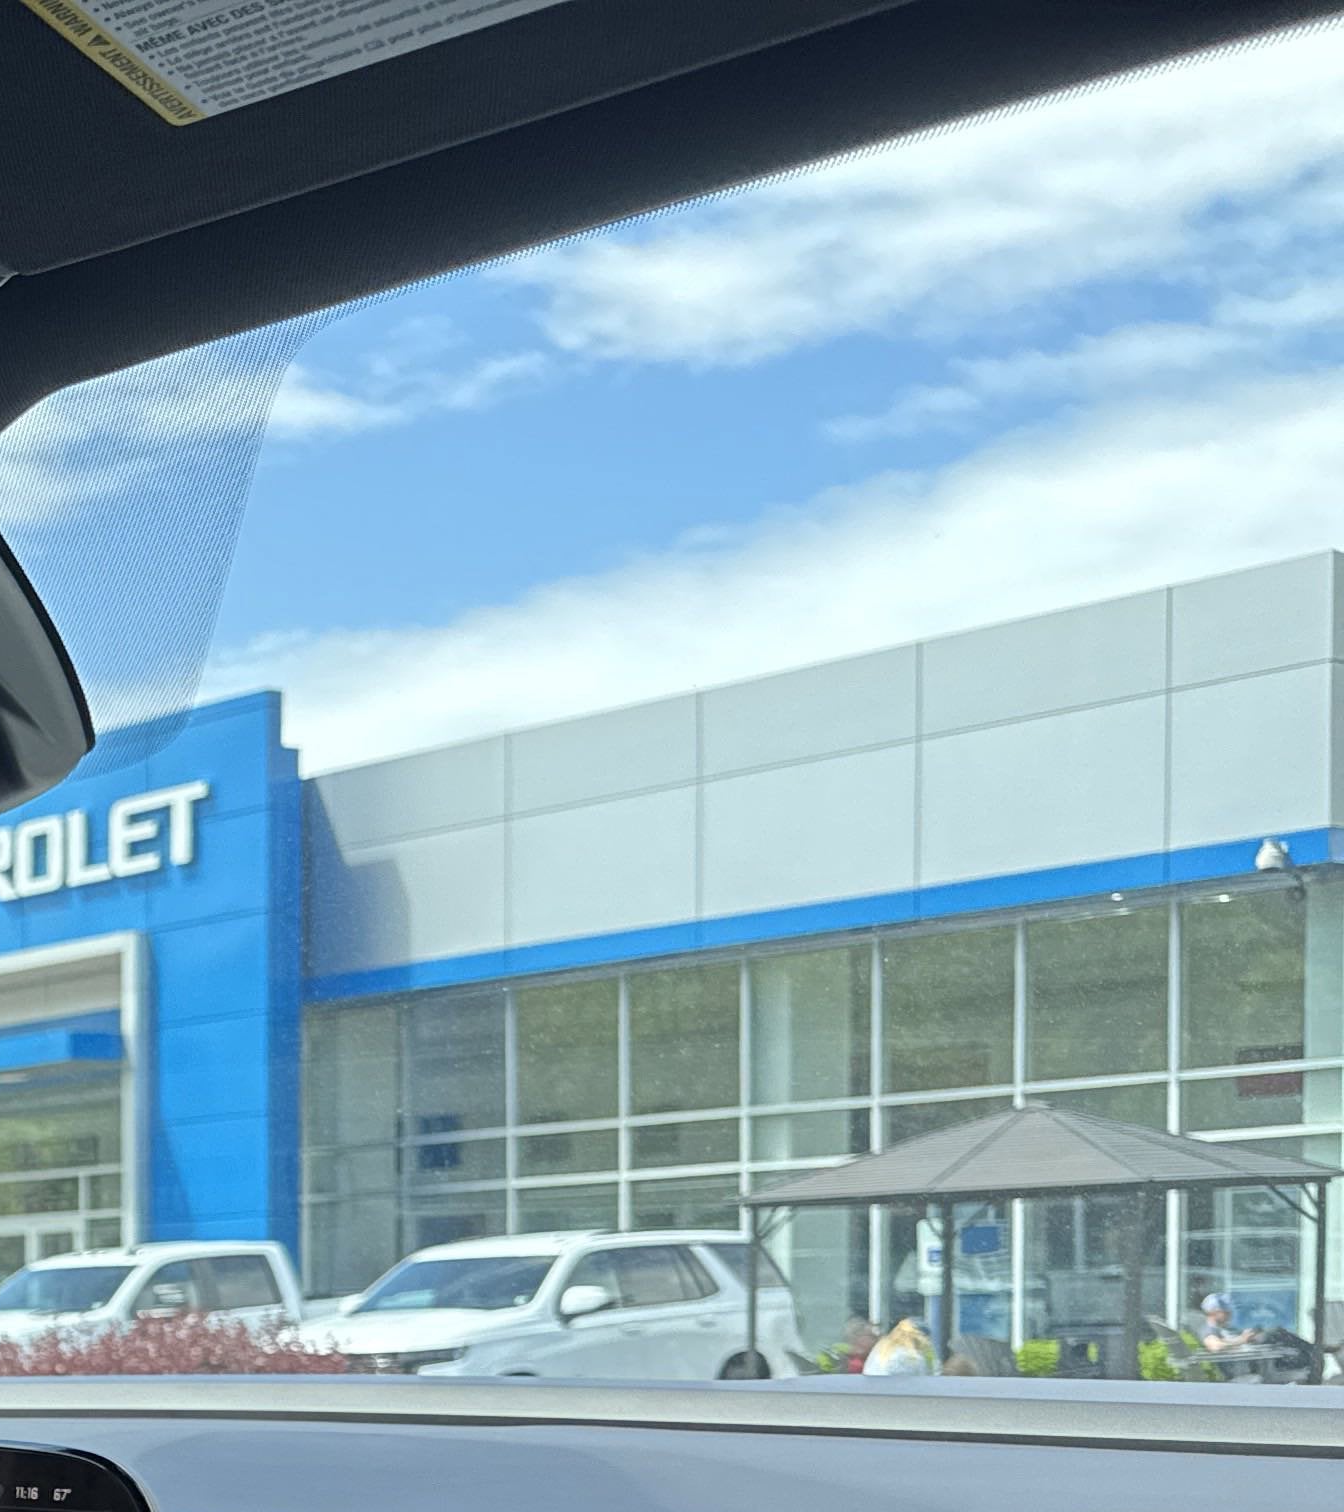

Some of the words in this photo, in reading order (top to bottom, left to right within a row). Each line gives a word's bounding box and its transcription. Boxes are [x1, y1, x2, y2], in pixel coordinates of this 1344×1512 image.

[186, 13, 230, 36] AVEC
[229, 2, 265, 20] DES
[99, 48, 197, 120] AVERTISSEMENT
[15, 1486, 39, 1500] 11:16
